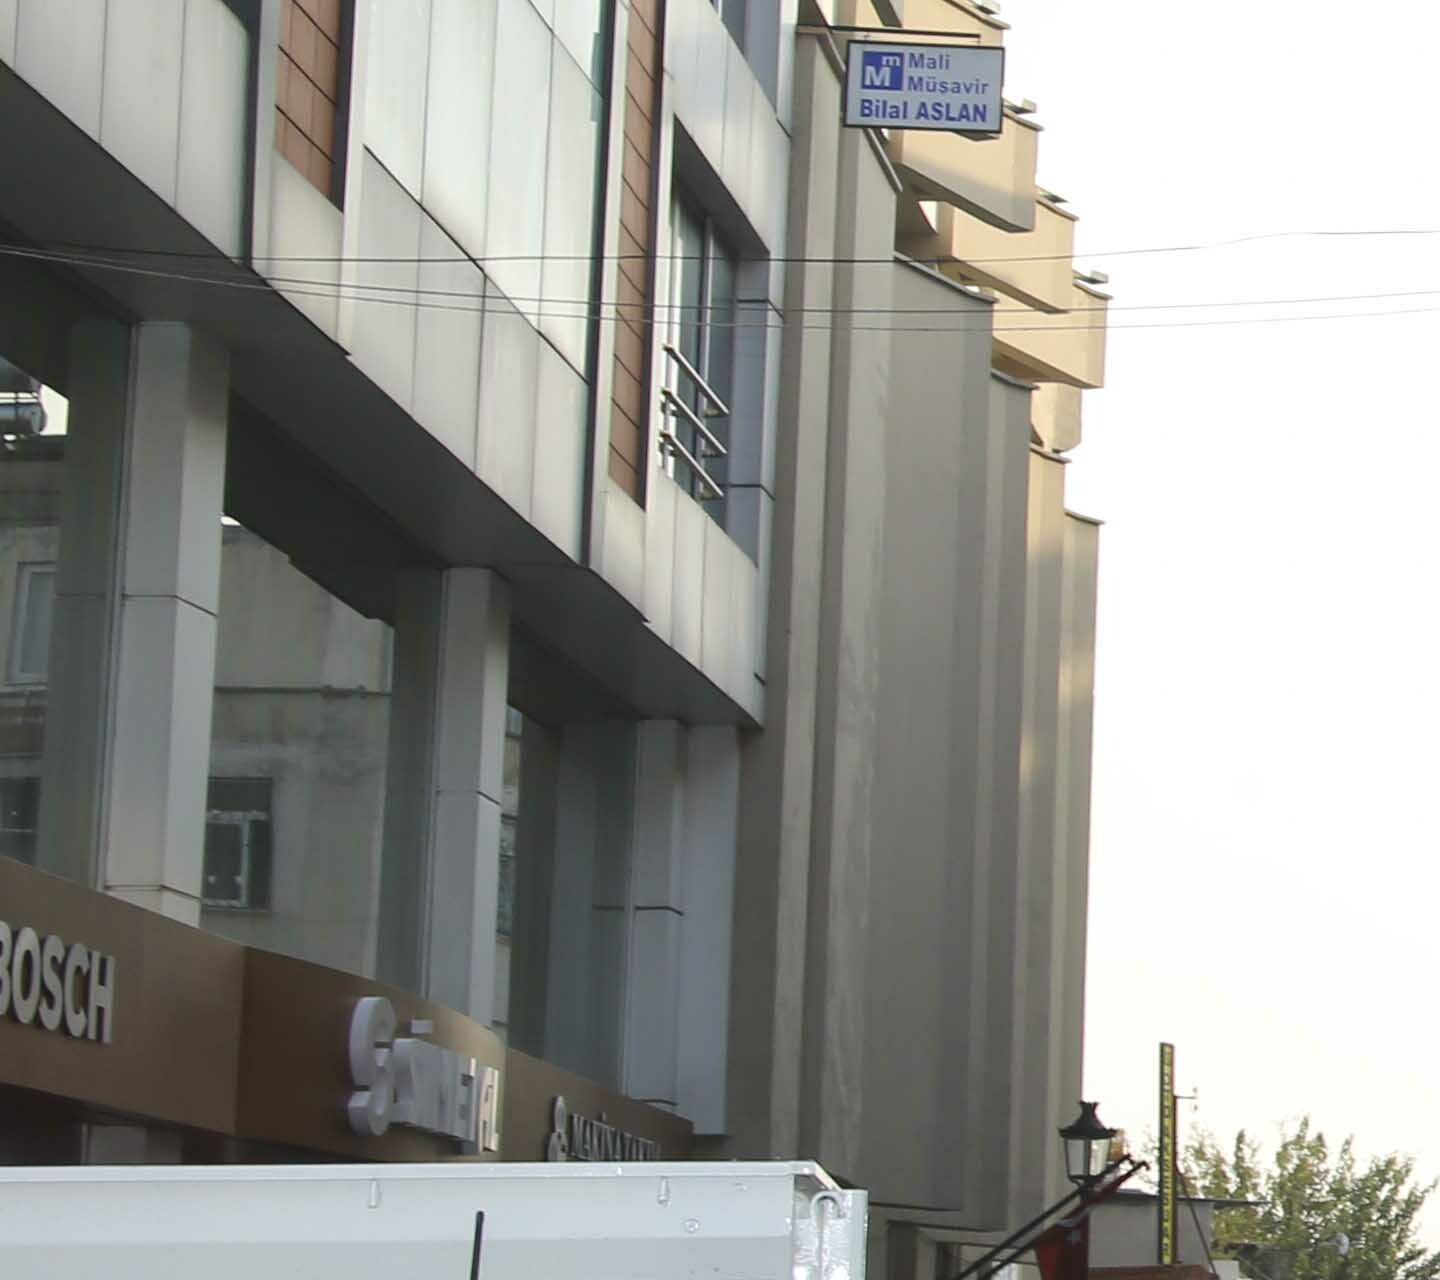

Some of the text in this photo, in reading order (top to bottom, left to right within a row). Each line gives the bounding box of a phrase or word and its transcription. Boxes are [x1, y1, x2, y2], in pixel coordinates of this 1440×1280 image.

[909, 53, 950, 70] Mali
[860, 99, 987, 123] Bilal ASLAN
